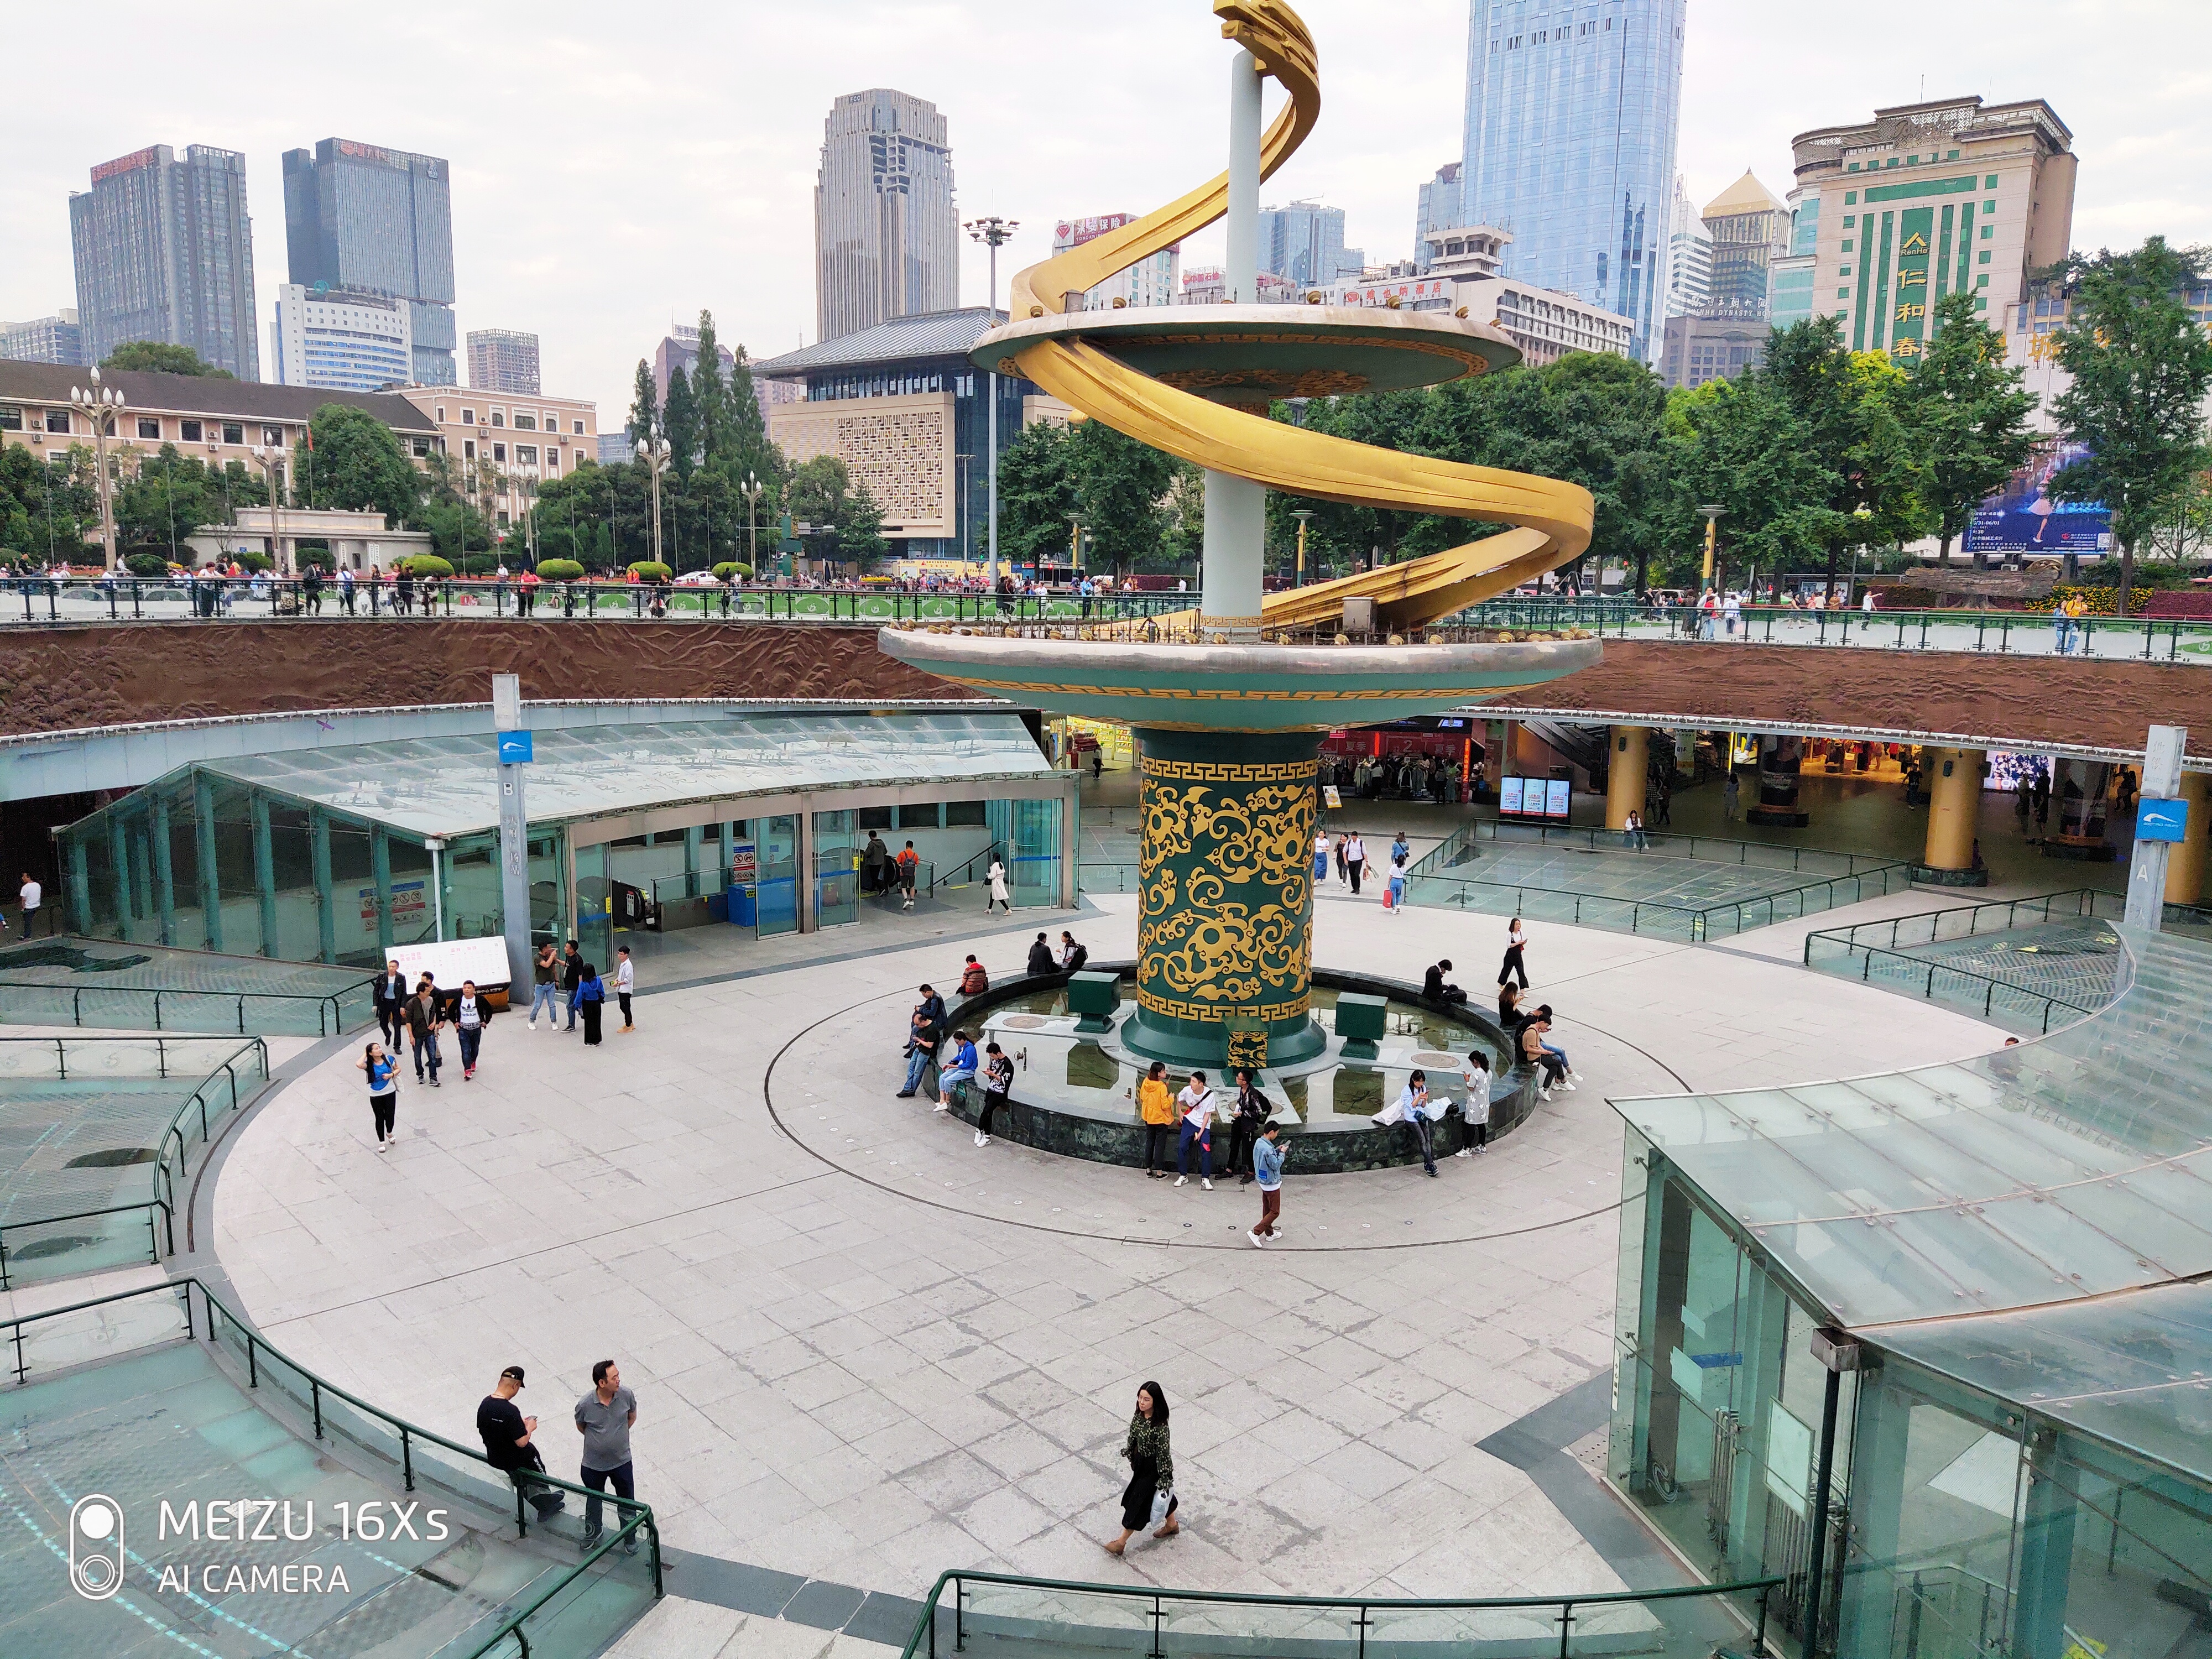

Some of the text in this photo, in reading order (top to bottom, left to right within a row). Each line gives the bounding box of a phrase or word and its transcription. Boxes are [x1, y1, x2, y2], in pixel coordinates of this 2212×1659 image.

[1076, 216, 1121, 234] 永安保险
[1366, 281, 1442, 300] 维也纳酒店
[1892, 269, 1927, 380] 仁和春
[1345, 741, 1366, 752] 夏季
[1435, 744, 1456, 754] 夏季
[503, 782, 514, 796] B
[2136, 864, 2149, 883] A
